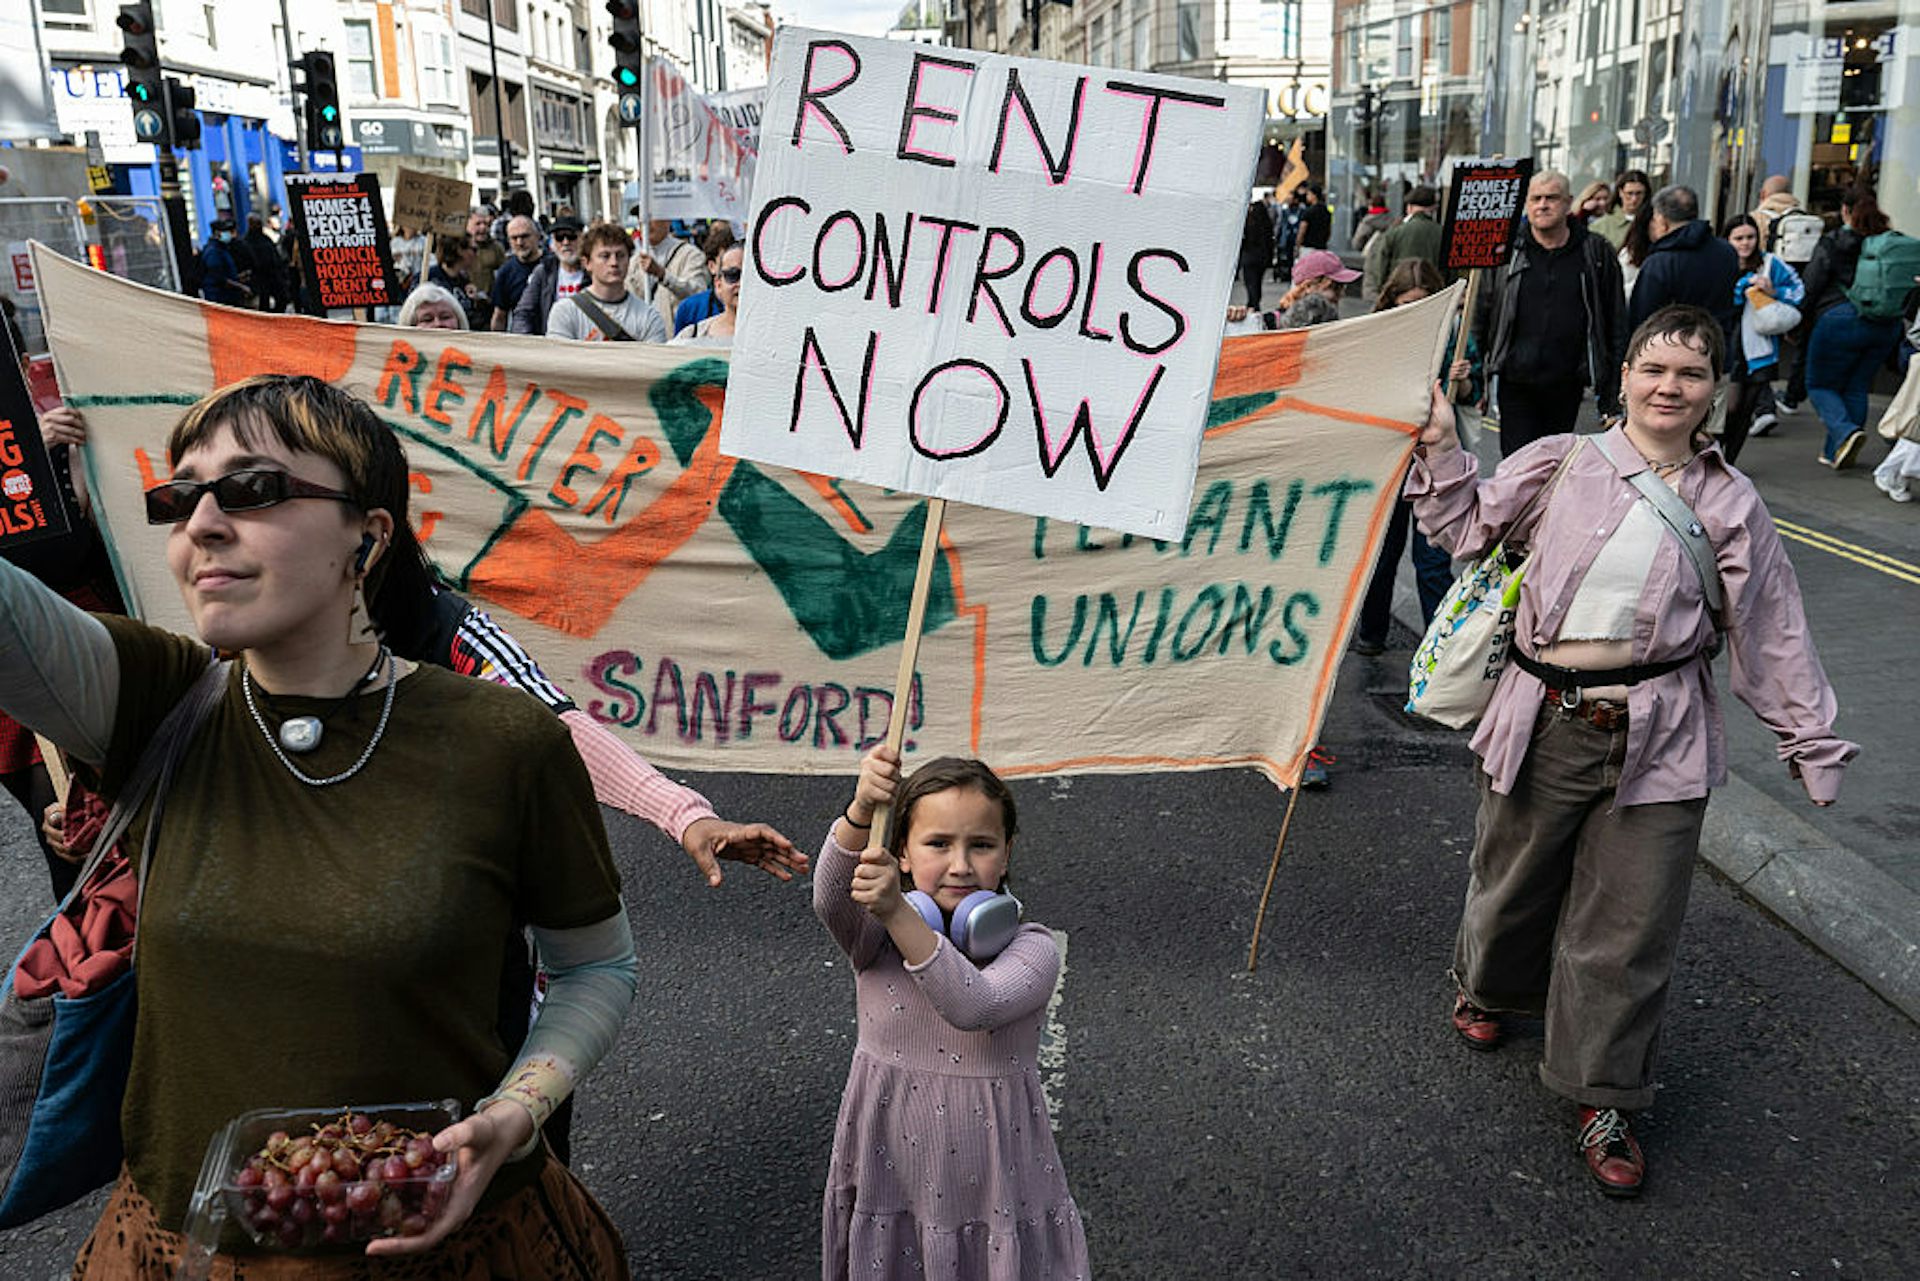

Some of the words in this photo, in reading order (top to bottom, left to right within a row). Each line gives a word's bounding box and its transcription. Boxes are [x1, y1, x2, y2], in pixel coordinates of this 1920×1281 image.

[791, 39, 1228, 196] RENT
[1461, 179, 1511, 194] HOMES
[1510, 177, 1520, 191] 4
[302, 198, 358, 216] HOMES
[360, 197, 371, 214] 4
[1458, 192, 1518, 210] PEOPLE
[1456, 209, 1479, 221] NOT
[1479, 208, 1515, 220] PROFIT
[305, 214, 376, 236] PEOPLE
[309, 235, 334, 249] NOT
[335, 233, 377, 248] PROFIT
[1461, 244, 1493, 257] RENT
[313, 246, 381, 264] COUNCIL
[315, 262, 384, 280] HOUSING
[752, 196, 1190, 359] CONTROLS
[320, 279, 331, 294] &
[332, 278, 369, 292] RENT
[790, 327, 1166, 492] NOW
[376, 339, 662, 524] RENTER
[1033, 478, 1376, 567] ANT
[1031, 581, 1321, 667] UNIONS
[585, 649, 925, 752] SANFORD!
